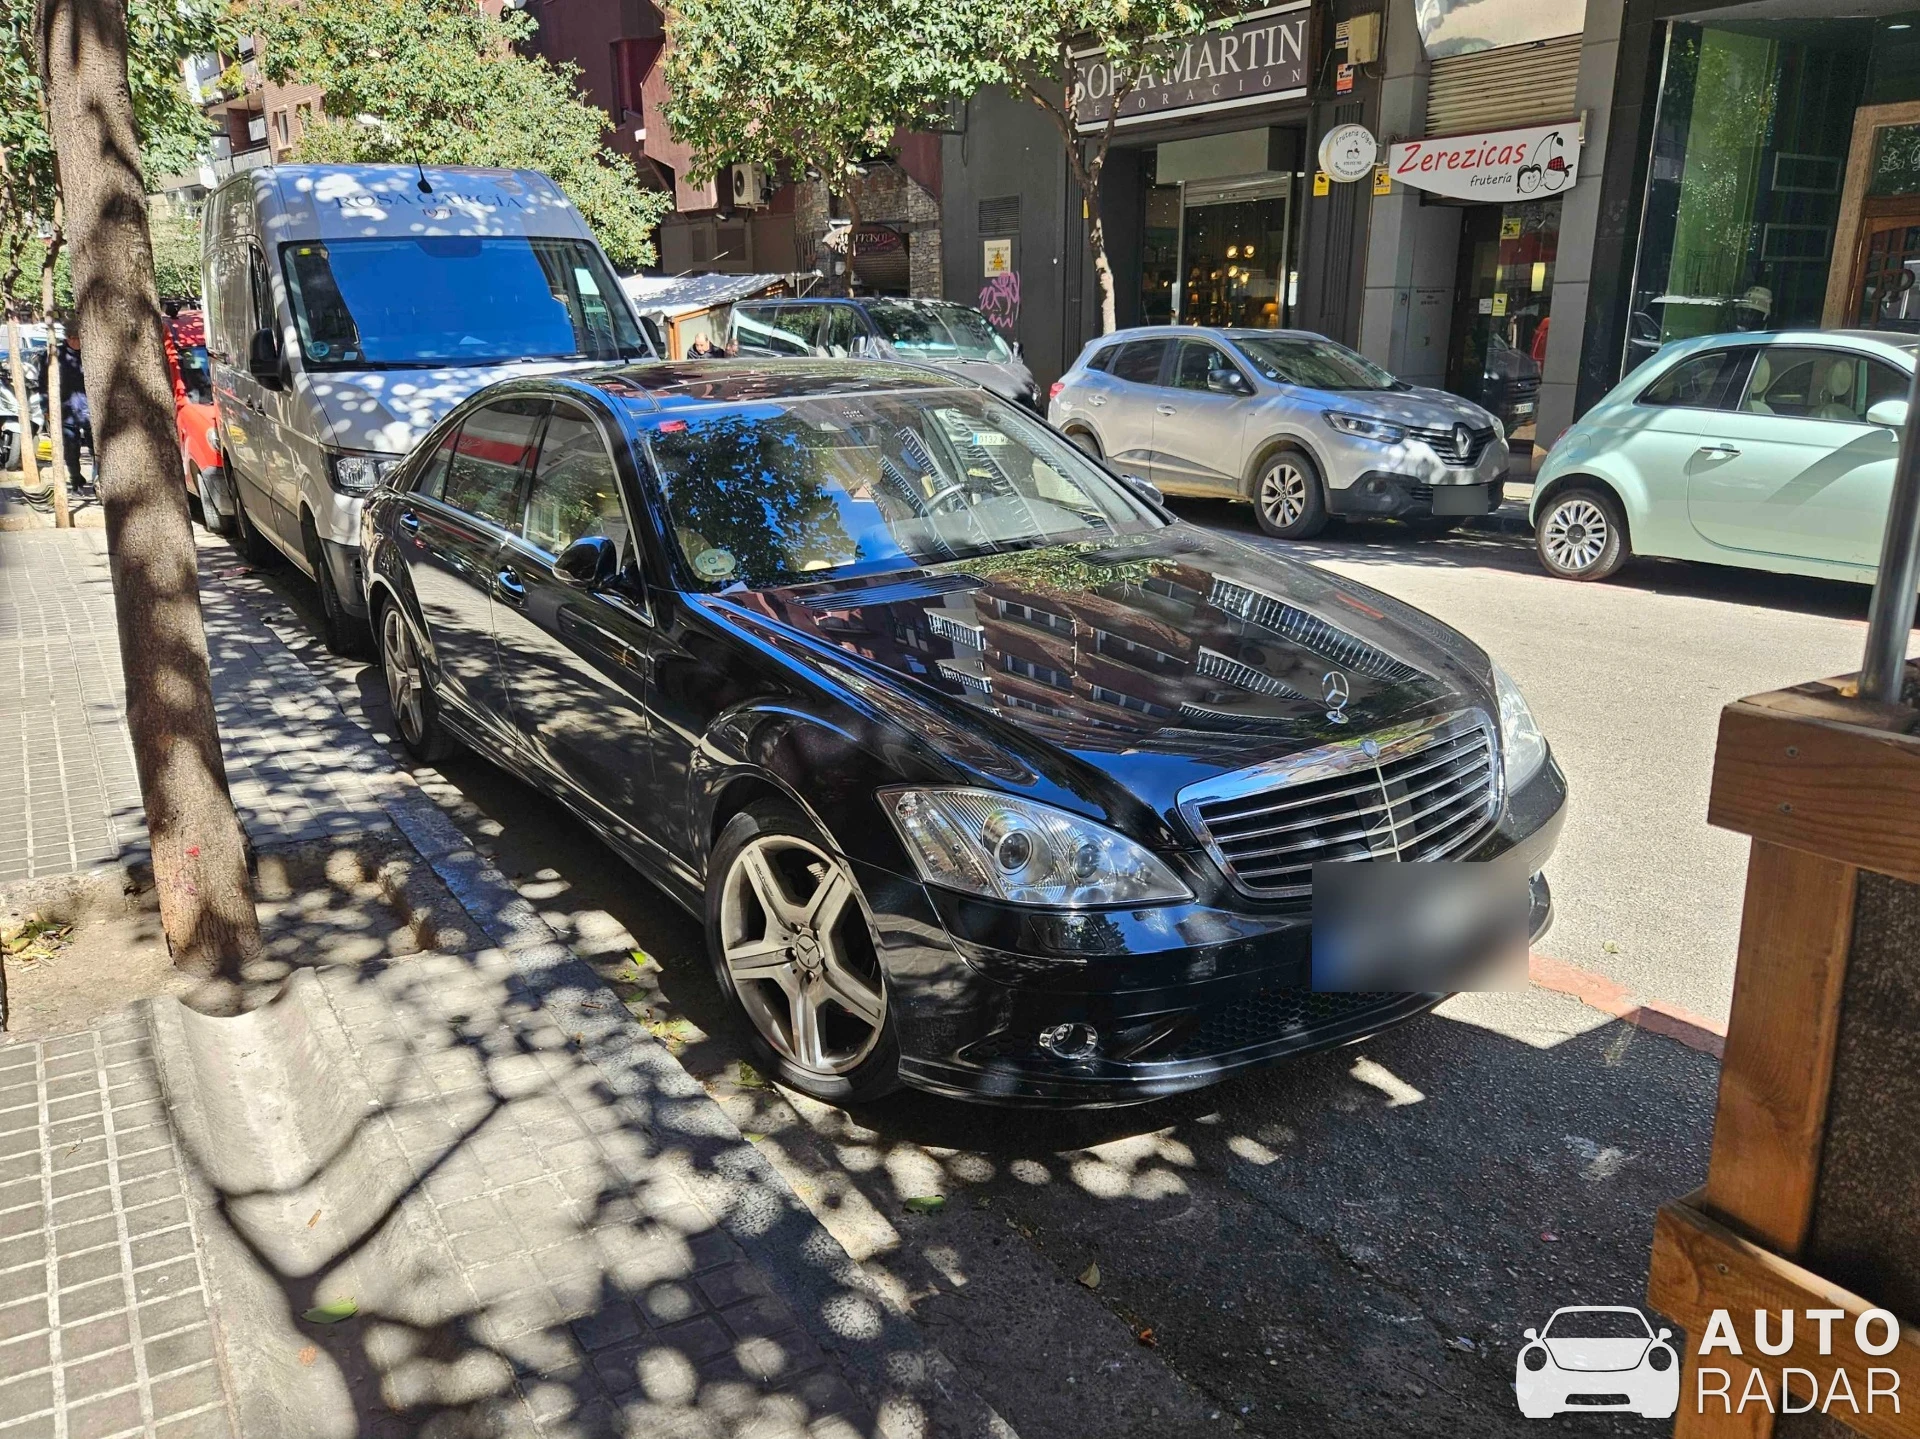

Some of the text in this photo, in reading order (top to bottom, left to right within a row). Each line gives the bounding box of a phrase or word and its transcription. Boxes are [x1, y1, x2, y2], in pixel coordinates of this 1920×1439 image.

[1075, 20, 1307, 103] SOFA MARTIN
[1094, 69, 1301, 116] EORACIÓN
[1397, 140, 1527, 174] Zerezicas
[1470, 172, 1513, 187] frutería
[333, 193, 523, 209] ROSA GARCÍA
[422, 208, 453, 218] 1971
